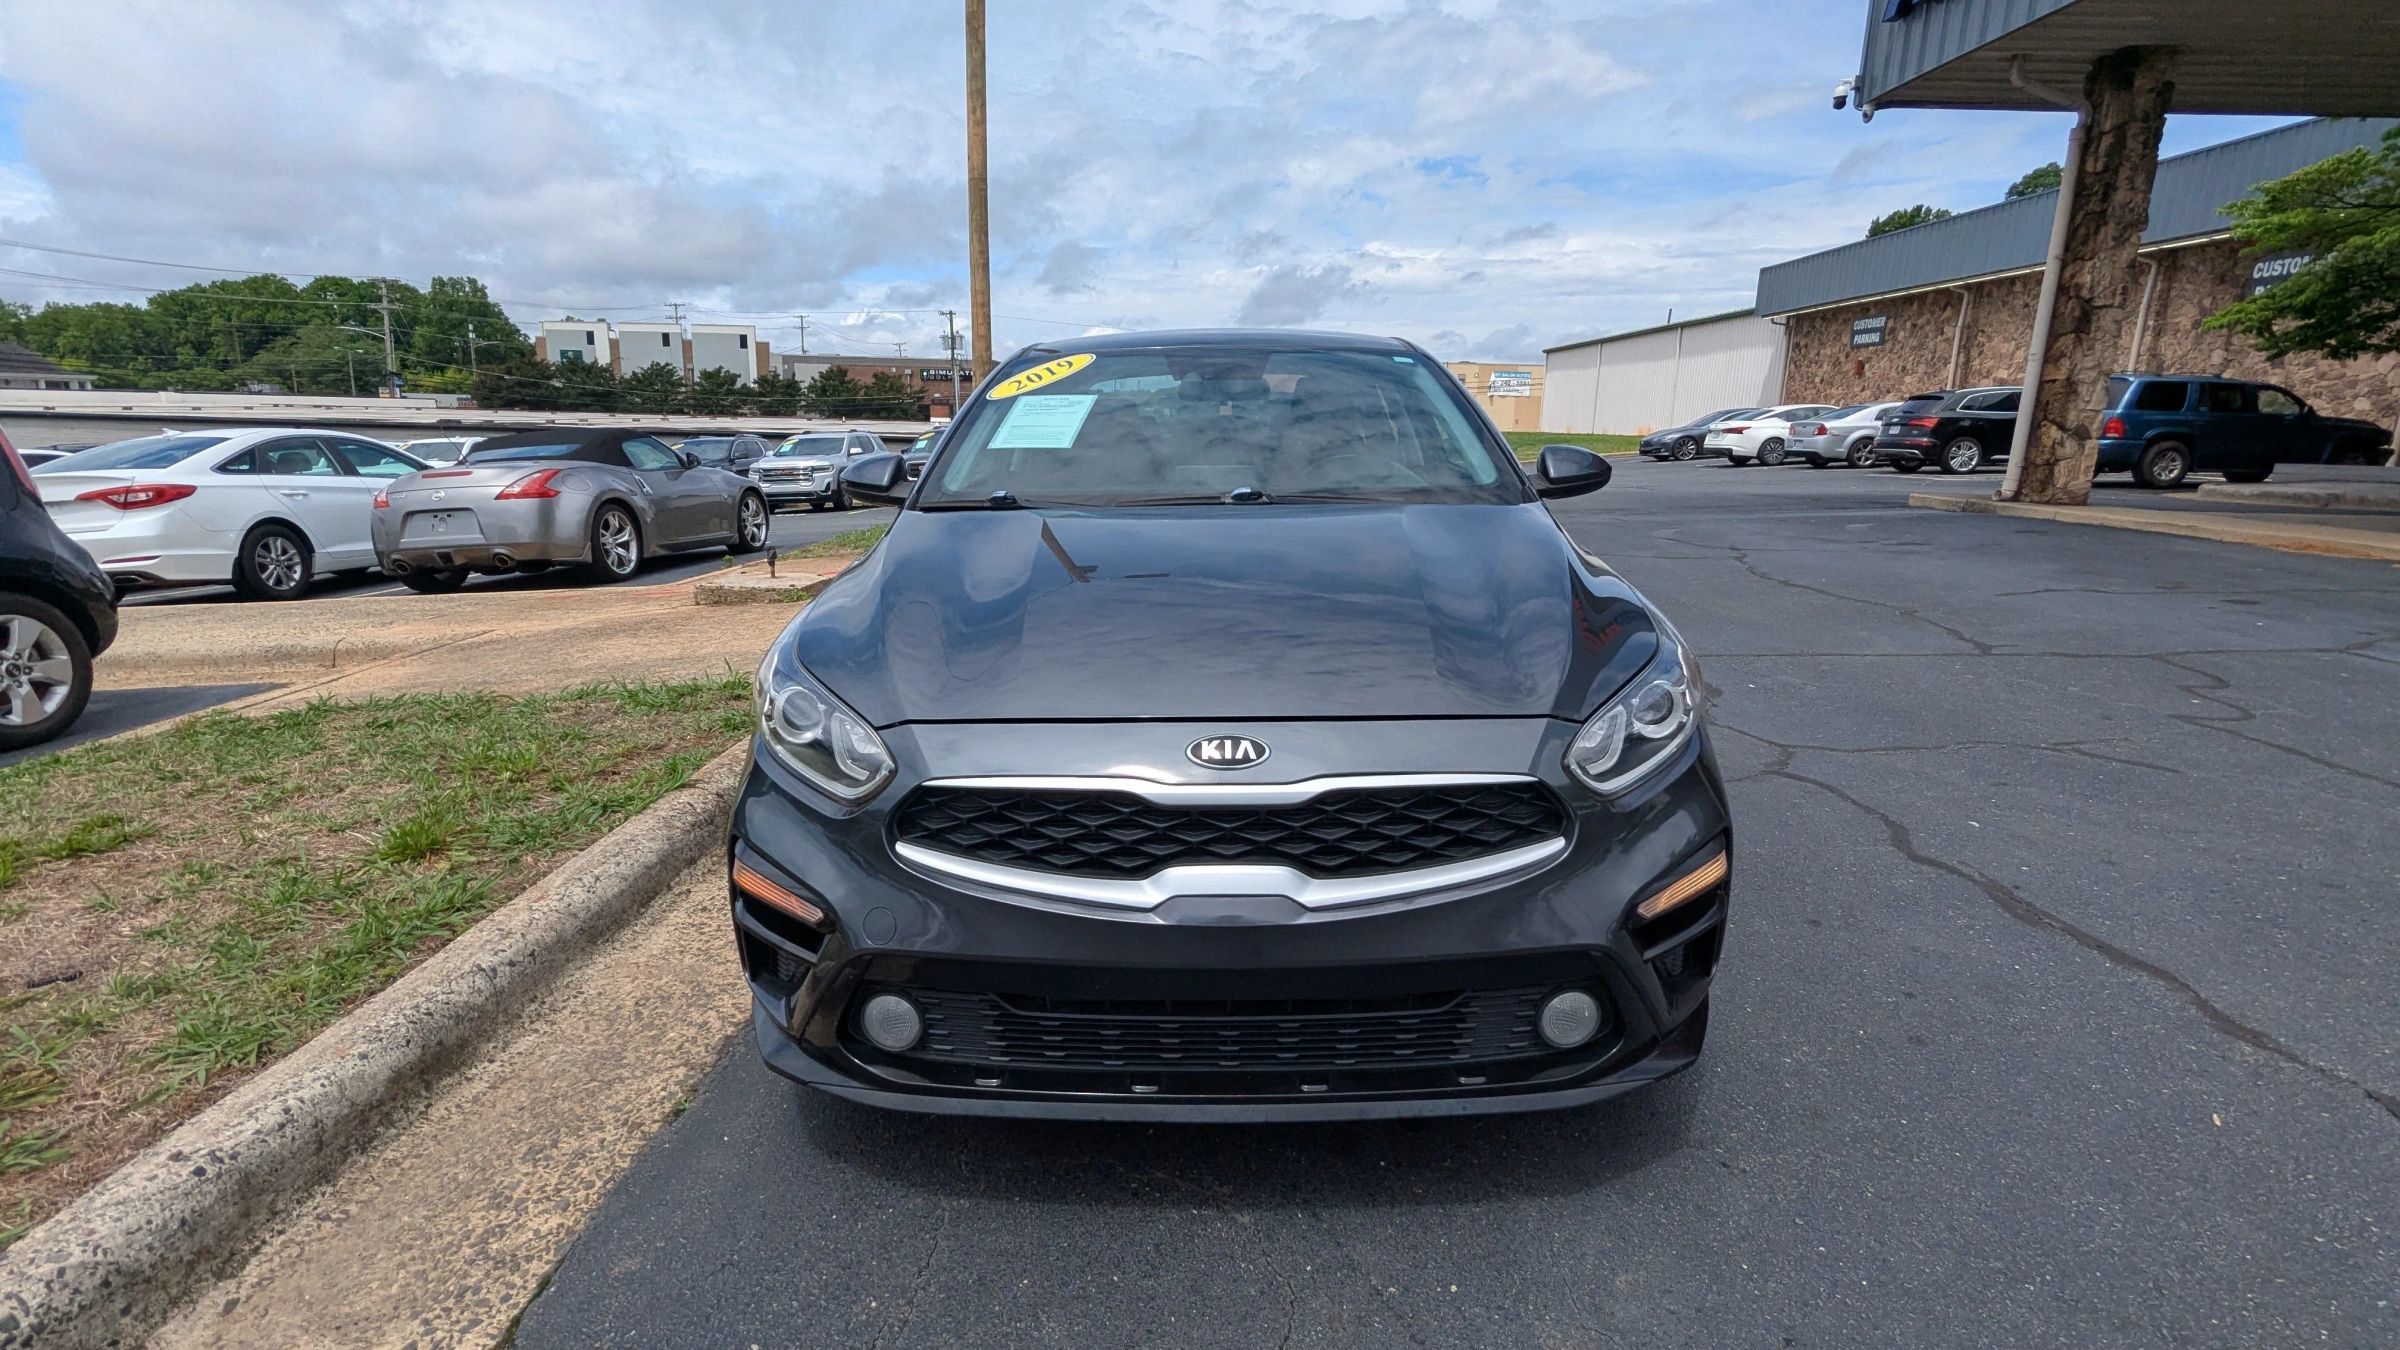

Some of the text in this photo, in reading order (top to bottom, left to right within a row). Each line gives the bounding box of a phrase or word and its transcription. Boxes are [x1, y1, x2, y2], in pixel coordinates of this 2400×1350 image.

[2252, 255, 2311, 279] CUSTO
[1853, 316, 1886, 330] CUSTOMER
[1853, 332, 1880, 344] PARKING
[1008, 360, 1074, 391] 2019
[1200, 740, 1257, 760] KIA
